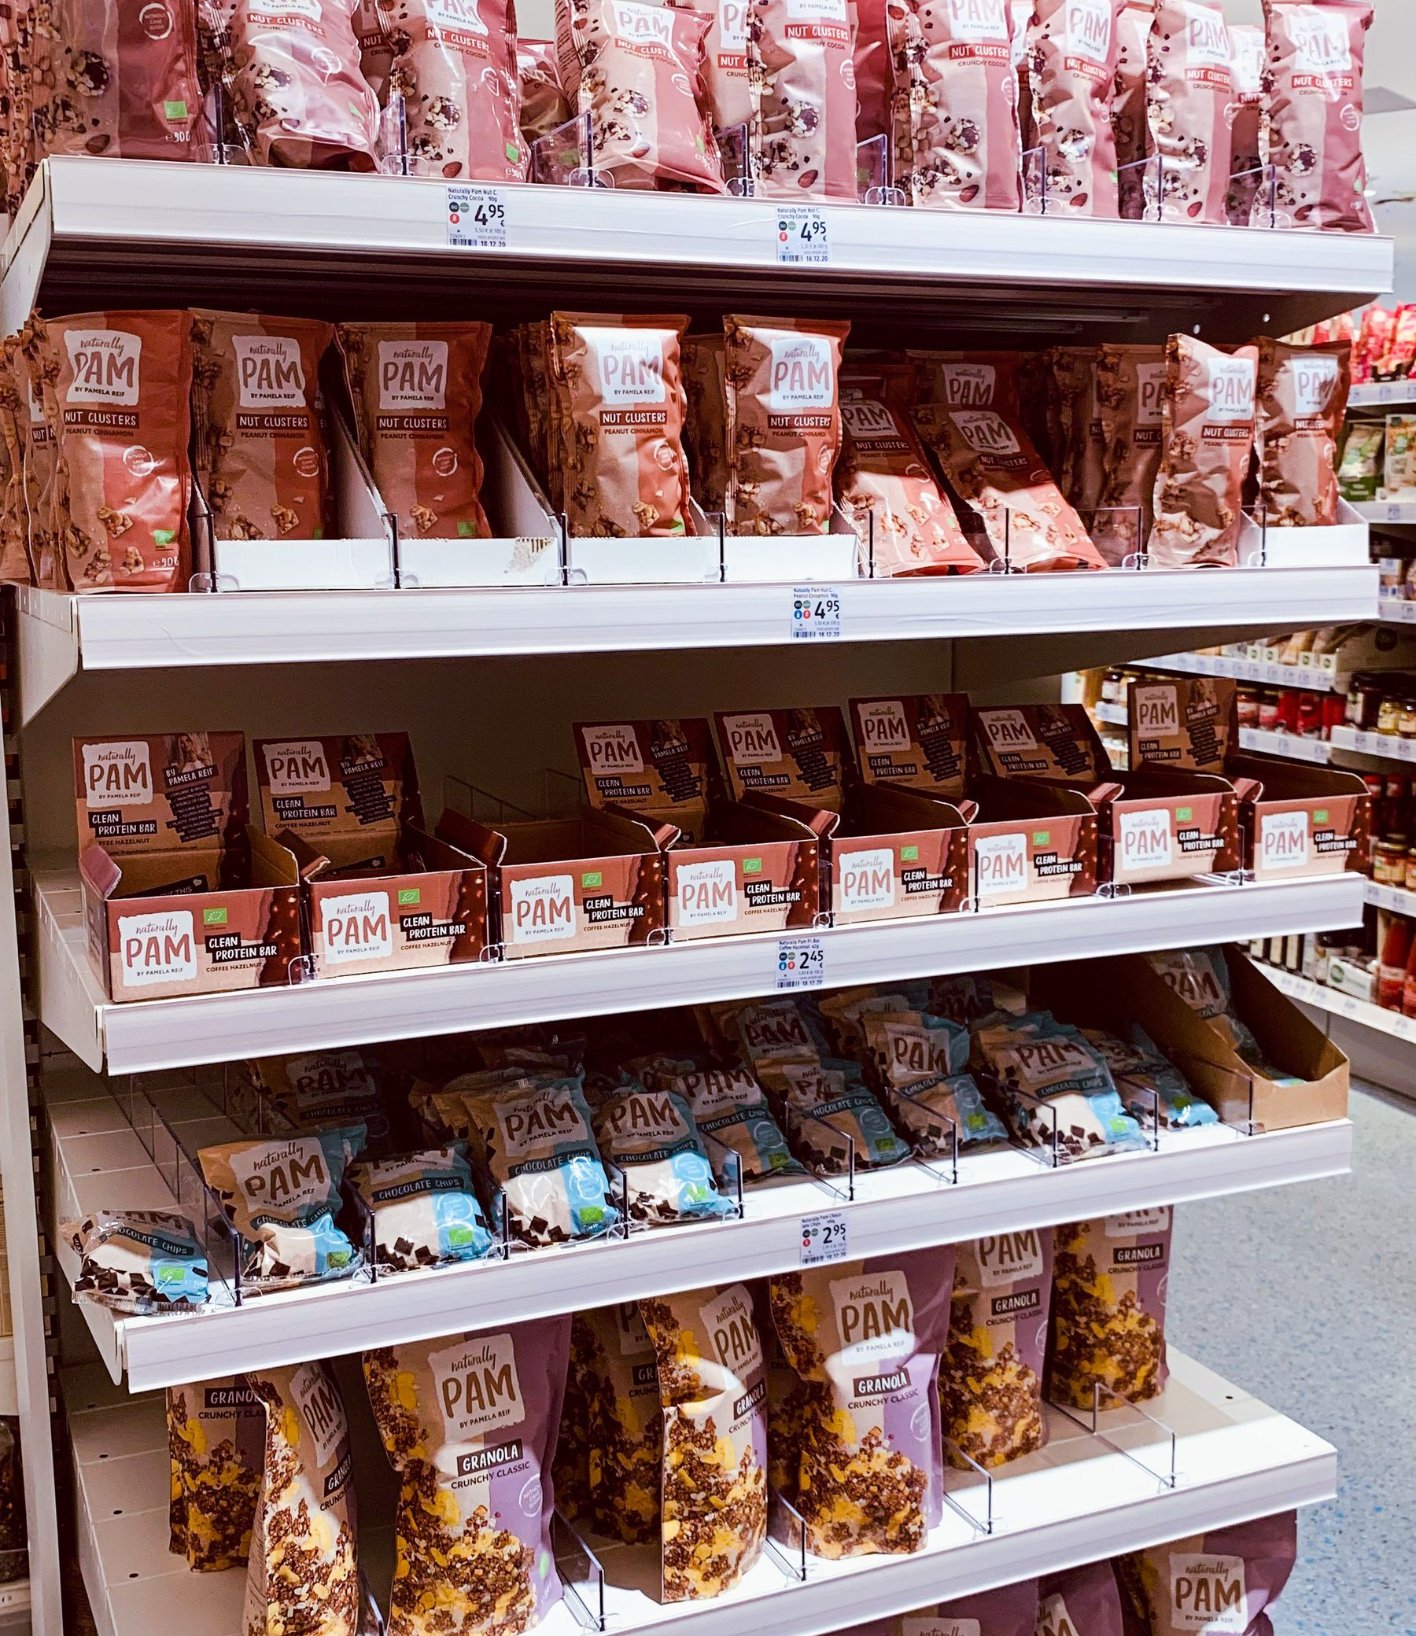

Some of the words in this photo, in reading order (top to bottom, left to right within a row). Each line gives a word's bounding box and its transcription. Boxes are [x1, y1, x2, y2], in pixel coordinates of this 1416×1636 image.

[619, 11, 669, 44] PAM
[788, 27, 808, 37] NUT
[812, 26, 848, 40] CLUSTERS
[1070, 8, 1108, 46] PAM
[1190, 19, 1228, 50] PAM
[827, 42, 845, 50] COCOA
[951, 47, 970, 57] NUT
[721, 56, 739, 66] NUT
[1186, 70, 1205, 80] NUT
[1293, 77, 1312, 87] NUT
[80, 337, 125, 357] naturally
[250, 343, 287, 362] naturally
[393, 346, 433, 365] naturally
[784, 344, 820, 364] naturally
[74, 351, 135, 388] PAM
[242, 357, 302, 390] PAM
[384, 361, 443, 394] PAM
[603, 355, 660, 386] PAM
[774, 361, 830, 391] PAM
[950, 378, 992, 406] PAM
[1213, 377, 1252, 405] PAM
[65, 411, 83, 423] NUT
[88, 412, 136, 426] CLUSTERS
[240, 416, 259, 427] NUT
[265, 417, 308, 428] CLUSTERS
[379, 418, 399, 428] NUT
[404, 418, 447, 429] CLUSTERS
[603, 413, 622, 423] NUT
[625, 413, 665, 423] CLUSTERS
[770, 417, 790, 426] NUT
[962, 422, 1012, 447] PAM
[1204, 428, 1221, 436] NUT
[856, 442, 871, 450] NUT
[1140, 702, 1175, 725] PAM
[865, 718, 906, 740] PAM
[988, 723, 1032, 741] PAM
[731, 730, 776, 751] PAM
[98, 748, 136, 766] naturally
[277, 746, 312, 759] naturally
[590, 741, 639, 762] PAM
[90, 763, 148, 791] PAM
[270, 757, 325, 780] PAM
[740, 769, 760, 777] CLEAN
[168, 771, 197, 786] PAMELA
[746, 777, 775, 785] PROTEIN
[605, 788, 635, 796] PROTEIN
[276, 800, 301, 808] CLEAN
[282, 809, 319, 819] PROTEIN
[320, 808, 336, 817] BAR
[92, 813, 119, 824] CLEAN
[98, 825, 137, 835] PROTEIN
[139, 823, 156, 833] BAR
[1179, 831, 1198, 840] CLEAN
[1315, 833, 1334, 841] CLEAN
[1125, 829, 1168, 855] PAM
[1184, 841, 1211, 850] PROTEIN
[1265, 830, 1304, 855] PAM
[1319, 841, 1344, 851] PROTEIN
[980, 853, 1023, 879] PAM
[1036, 856, 1056, 864] CLEAN
[1040, 864, 1068, 875] PROTEIN
[690, 867, 723, 884] naturally
[844, 868, 890, 897] PAM
[904, 871, 925, 881] CLEAN
[908, 880, 938, 891] PROTEIN
[940, 879, 953, 888] BAR
[526, 882, 560, 899] naturally
[682, 881, 732, 910] PAM
[747, 883, 770, 894] CLEAN
[752, 893, 785, 904] PROTEIN
[786, 892, 800, 901] BAR
[336, 900, 376, 917] naturally
[517, 896, 571, 927] PAM
[586, 898, 611, 909] CLEAN
[403, 916, 430, 928] CLEAN
[591, 908, 627, 920] PROTEIN
[629, 907, 644, 917] BAR
[135, 918, 178, 937] naturally
[328, 913, 387, 947] PAM
[409, 926, 447, 939] PROTEIN
[449, 924, 466, 935] BAR
[126, 933, 191, 968] PAM
[209, 936, 238, 948] CLEAN
[216, 948, 257, 961] PROTEIN
[259, 945, 277, 956] BAR
[1015, 1043, 1085, 1069] PAM
[297, 1068, 367, 1093] PAM
[683, 1070, 754, 1098] PAM
[505, 1102, 579, 1141] PAM
[610, 1097, 681, 1134] PAM
[253, 1142, 304, 1171] naturally
[515, 1156, 563, 1175] CHOCOLATE
[244, 1154, 325, 1200] PAM
[379, 1179, 431, 1200] CHOCOLATE
[435, 1179, 460, 1188] CHIPS
[161, 1242, 187, 1254] CHIPS
[979, 1230, 1038, 1266] PAM
[1117, 1247, 1160, 1261] GRANOLA
[850, 1280, 893, 1303] naturally
[996, 1292, 1037, 1312] GRANOLA
[841, 1298, 910, 1343] PAM
[986, 1313, 1020, 1327] CRUNCHY
[714, 1315, 759, 1367] PAM
[451, 1346, 496, 1372] naturally
[442, 1364, 516, 1419] PAM
[858, 1372, 907, 1394] GRANOLA
[736, 1384, 764, 1415] GRANOLA
[848, 1395, 888, 1409] CRUNCHY
[198, 1410, 240, 1419] CRUNCHY
[302, 1381, 342, 1442] PAM
[470, 1413, 497, 1426] PAMELA
[463, 1444, 519, 1471] GRANOLA
[451, 1472, 496, 1490] CRUNCHY
[496, 1461, 530, 1478] CLASSIC
[1185, 1562, 1229, 1582] naturally
[1176, 1577, 1241, 1613] PAM
